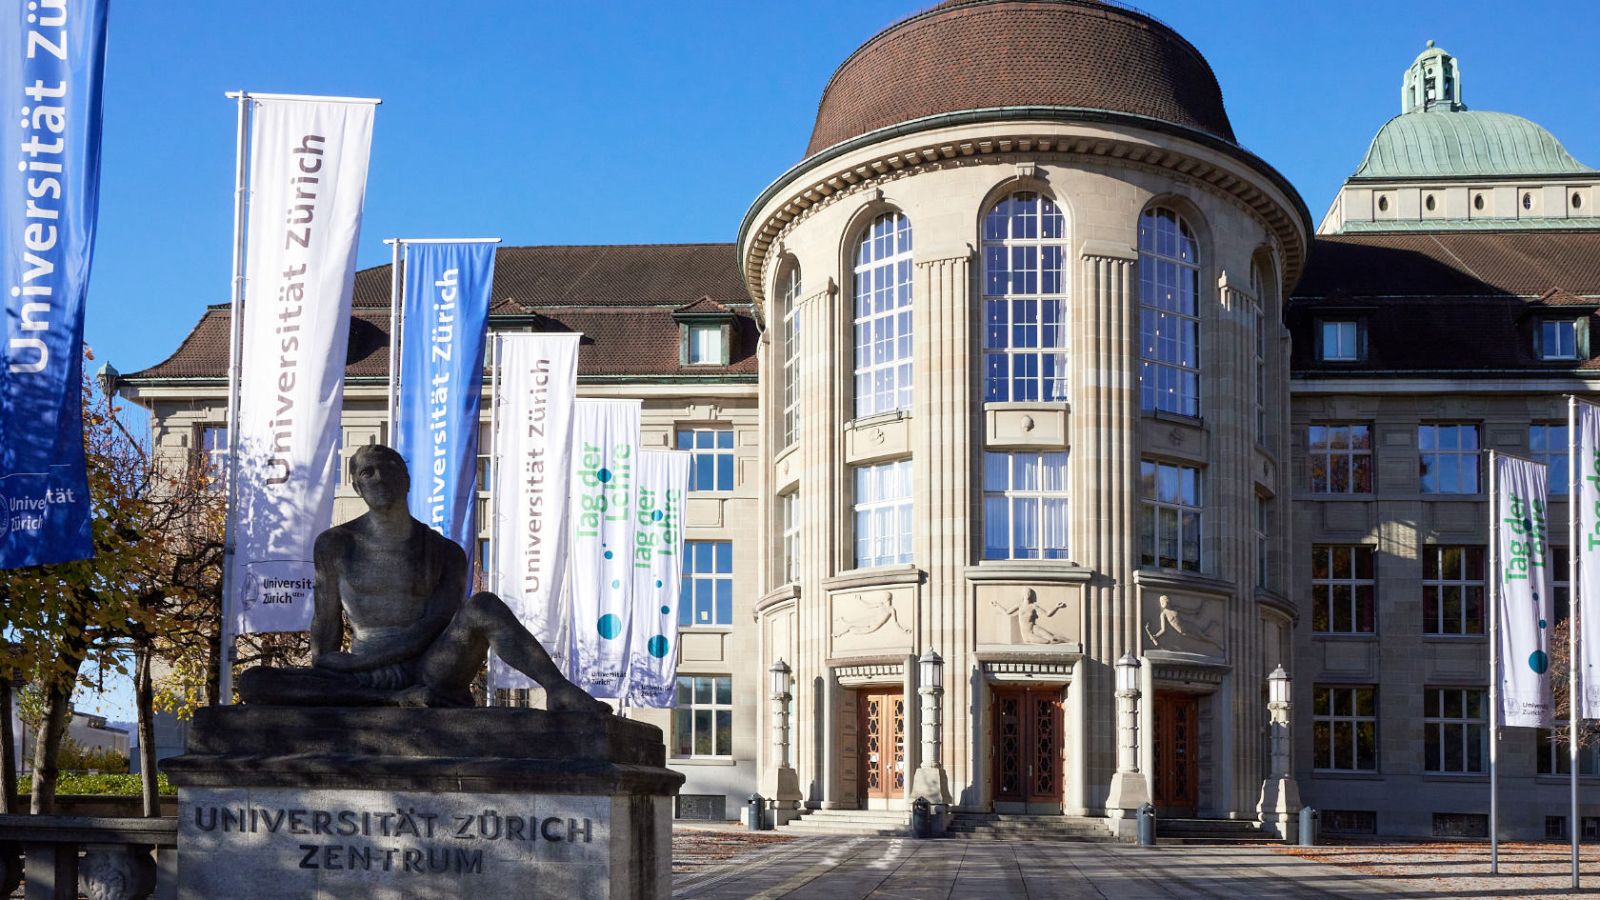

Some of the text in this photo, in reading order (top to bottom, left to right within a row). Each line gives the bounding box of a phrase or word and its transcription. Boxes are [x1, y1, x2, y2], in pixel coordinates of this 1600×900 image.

[9, 79, 67, 374] Universität
[266, 134, 326, 485] Universität Zürich
[432, 267, 458, 364] Zürich
[525, 358, 550, 593] Universität Zürich
[576, 441, 608, 542] Tag der
[604, 443, 631, 521] Lehre
[1504, 492, 1532, 584] Tag der
[1528, 498, 1547, 568] Lehre
[263, 577, 316, 590] Universit
[195, 806, 593, 843] UNIVERSITÄT ZÜRICH
[299, 844, 482, 874] ZENTRUM
